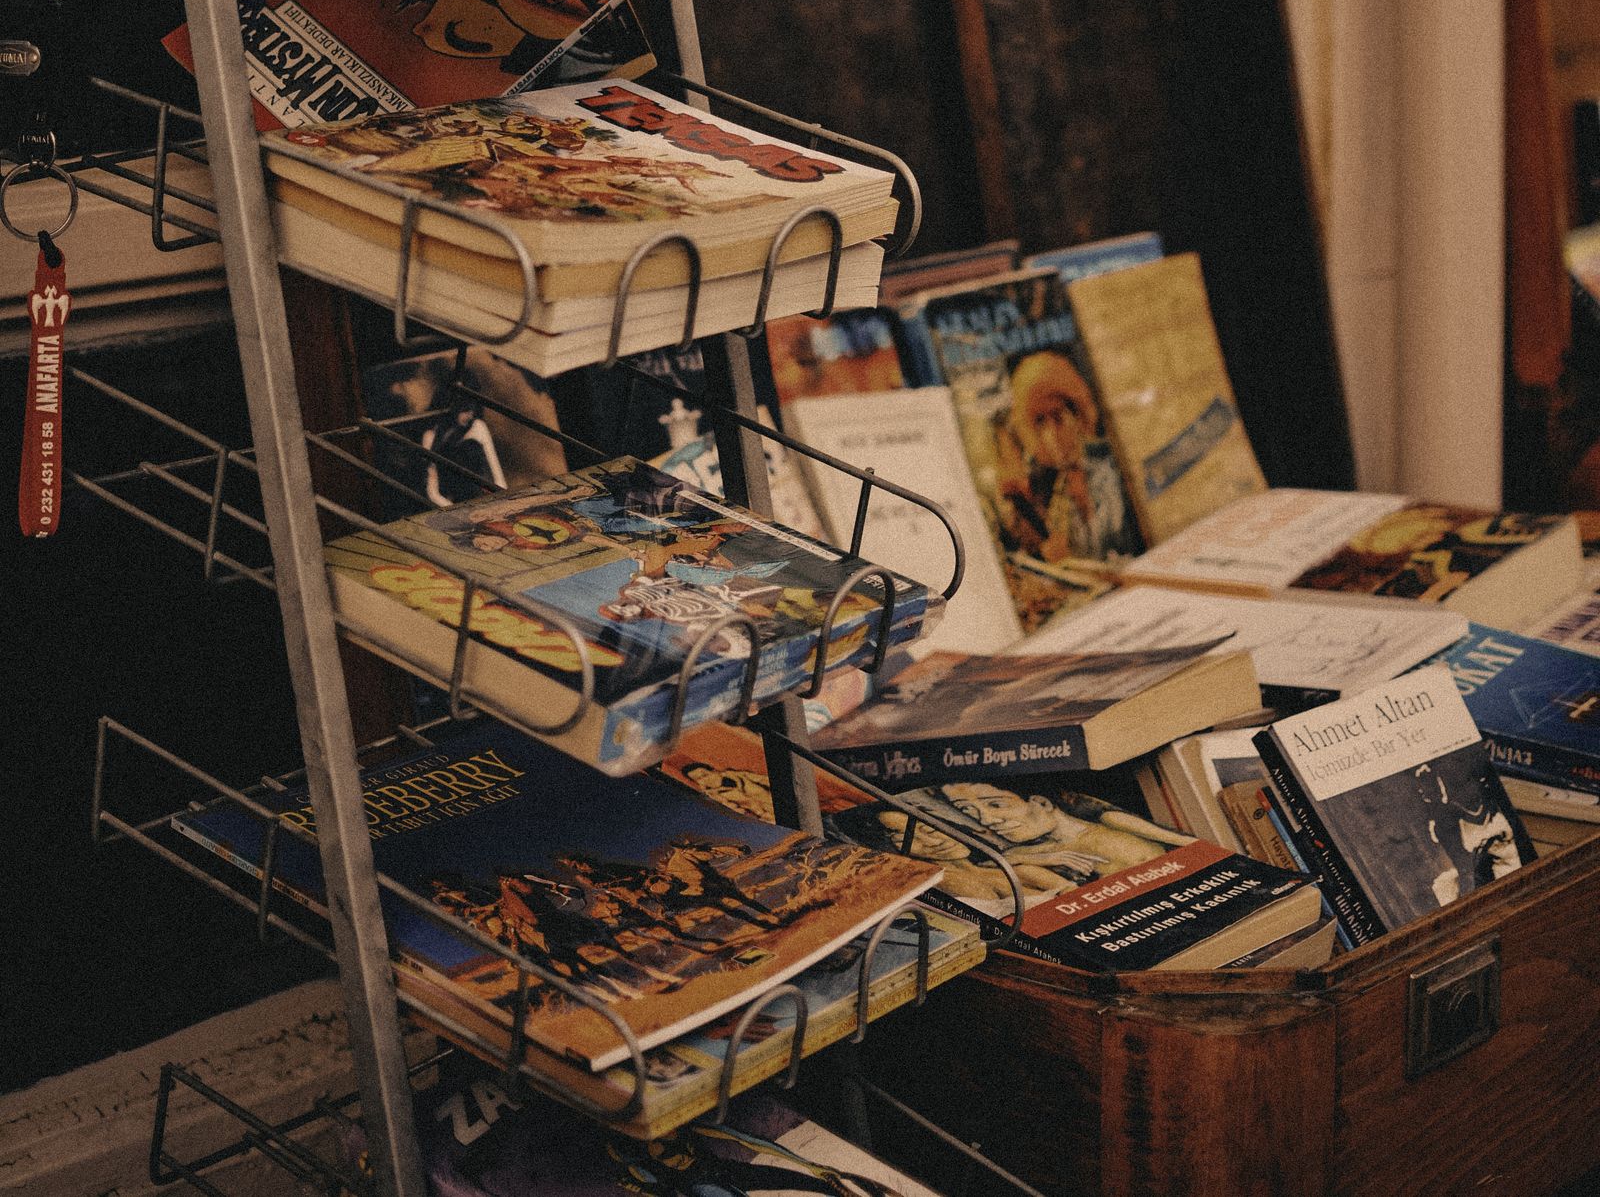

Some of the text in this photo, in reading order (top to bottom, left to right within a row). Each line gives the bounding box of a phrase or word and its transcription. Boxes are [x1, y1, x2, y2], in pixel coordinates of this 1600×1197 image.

[283, 5, 335, 50] DEDEKTİFİ
[533, 46, 564, 75] DOKTOR
[36, 334, 61, 414] ANAFARTA
[40, 421, 54, 525] 0 232 431 18 58
[943, 747, 979, 768] Ömür
[982, 746, 1018, 767] Boyu
[1019, 739, 1072, 762] Sürecek
[1290, 689, 1436, 757] Ahmet Altan
[1371, 739, 1396, 759] Bir
[1397, 725, 1428, 749] Yer
[279, 749, 527, 839] BEBERRY
[385, 754, 450, 783] GIRAUD
[384, 812, 443, 835] TABUT
[479, 784, 522, 806] AĞIT
[1271, 767, 1297, 803] Ahmet
[1296, 807, 1316, 838] Altan
[1055, 860, 1187, 916] Dr. Erdal Atabek
[1074, 868, 1242, 945] Kışkırtılmış Erkeklik
[1100, 877, 1263, 955] Bastırılmış Kadınlık
